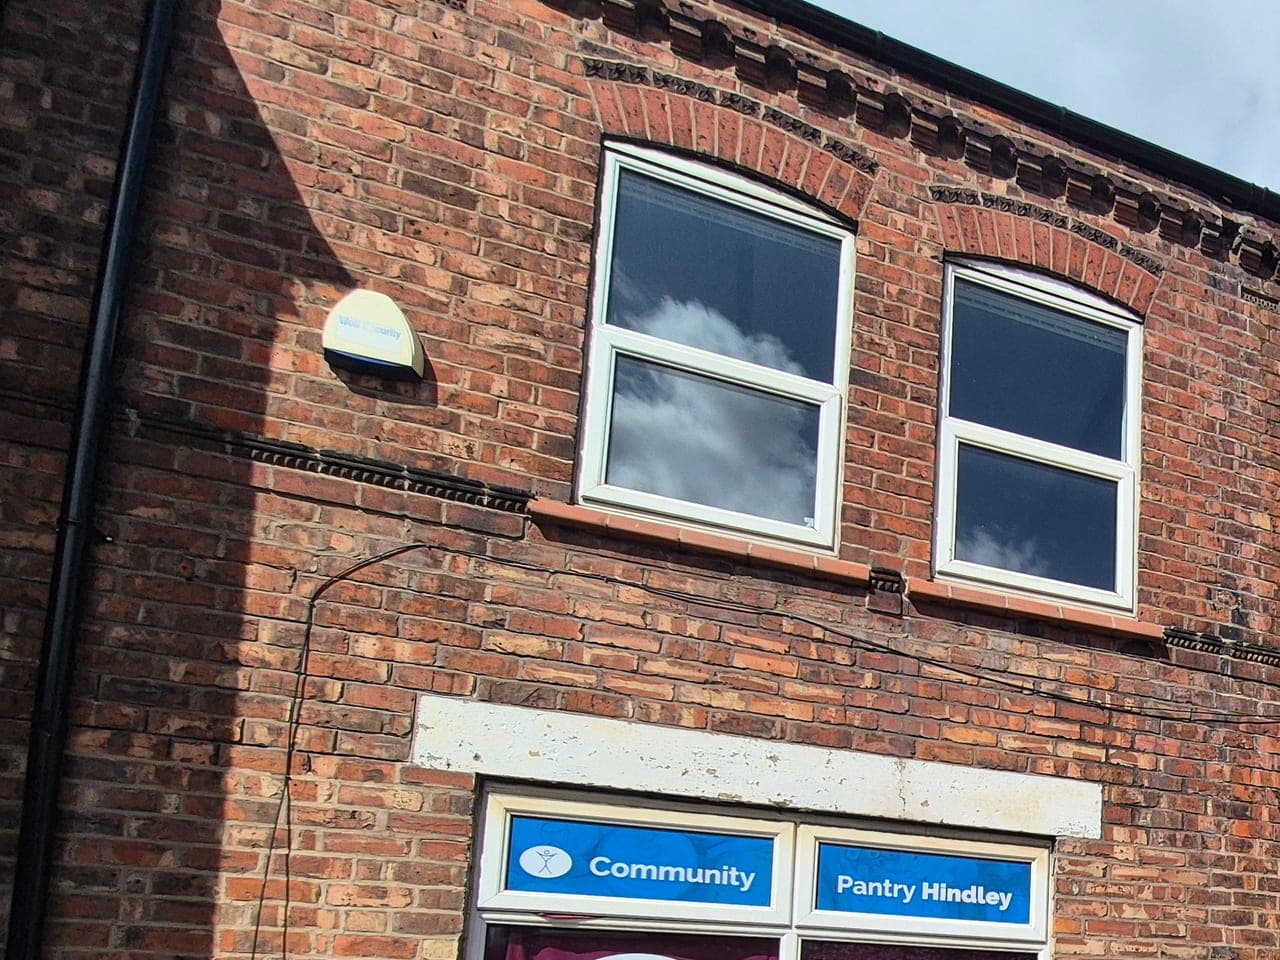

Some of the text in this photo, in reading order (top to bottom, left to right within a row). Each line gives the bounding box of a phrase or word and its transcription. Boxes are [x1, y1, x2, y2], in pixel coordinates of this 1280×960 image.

[589, 856, 756, 892] Community
[836, 875, 1013, 911] Pantry Hindley
